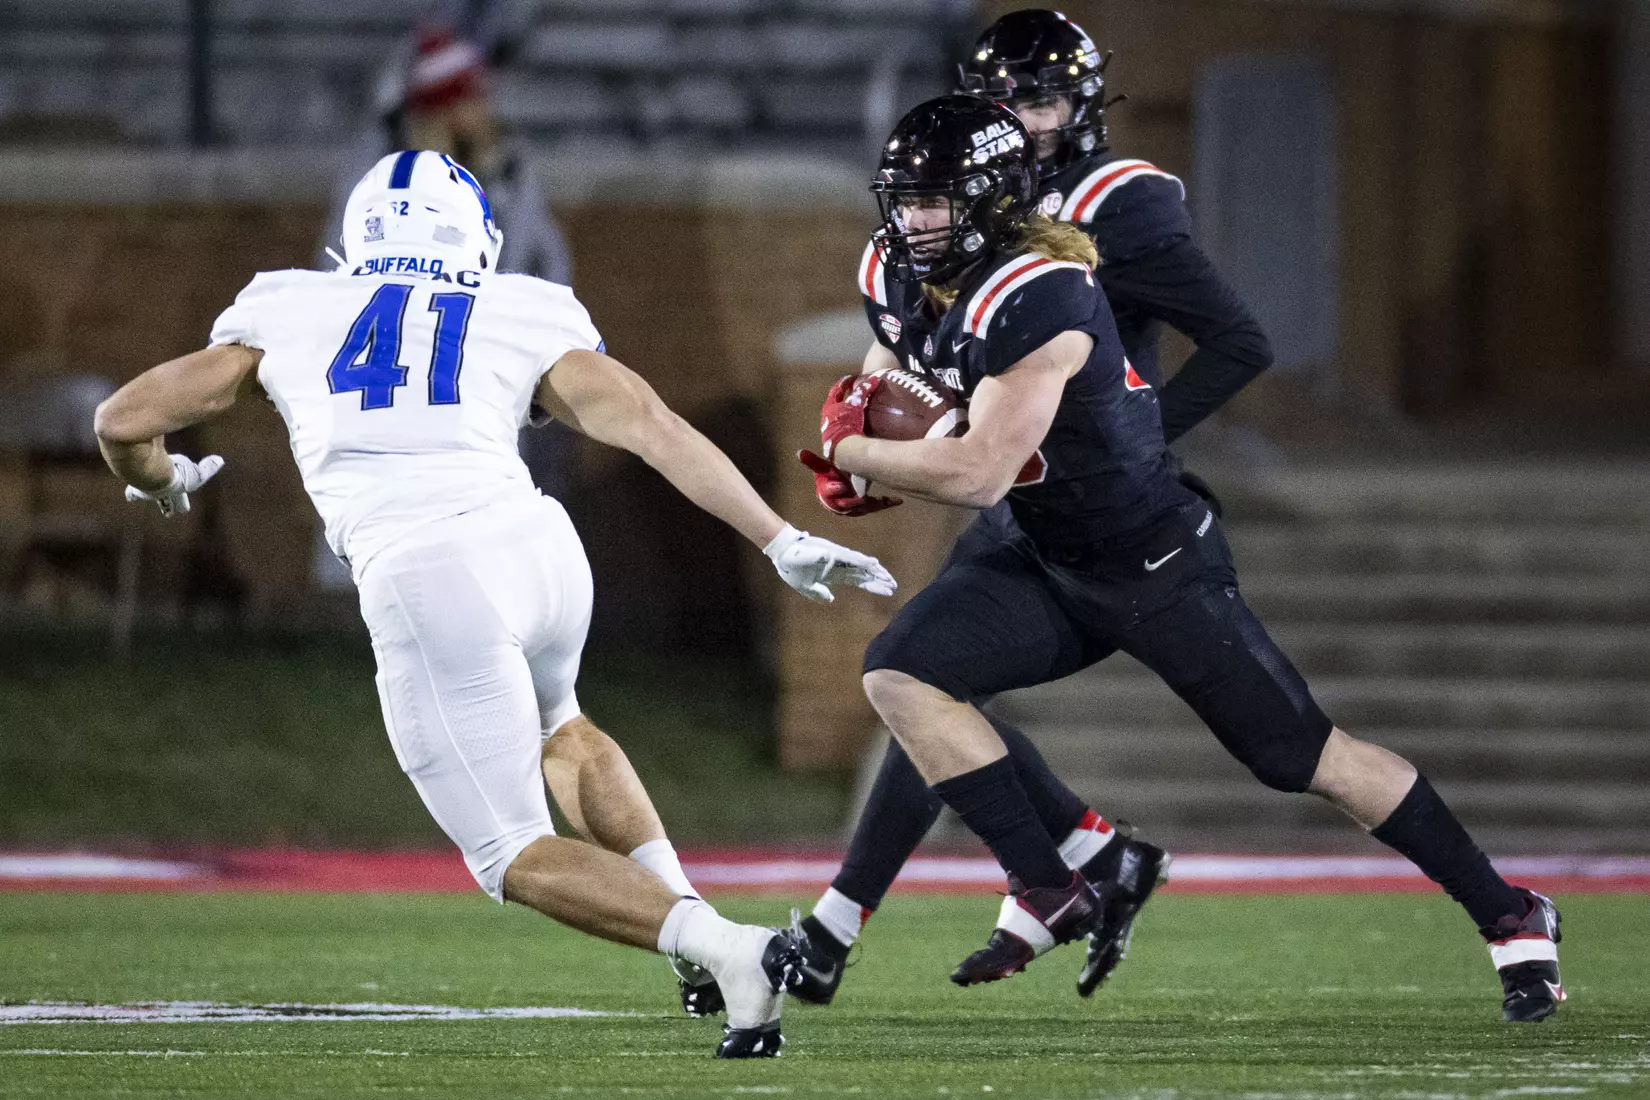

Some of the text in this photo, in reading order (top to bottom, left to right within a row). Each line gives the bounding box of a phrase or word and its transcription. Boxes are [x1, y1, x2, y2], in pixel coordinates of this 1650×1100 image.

[971, 120, 1014, 148] BALL
[365, 257, 443, 275] BUFFALO
[326, 283, 476, 411] 41
